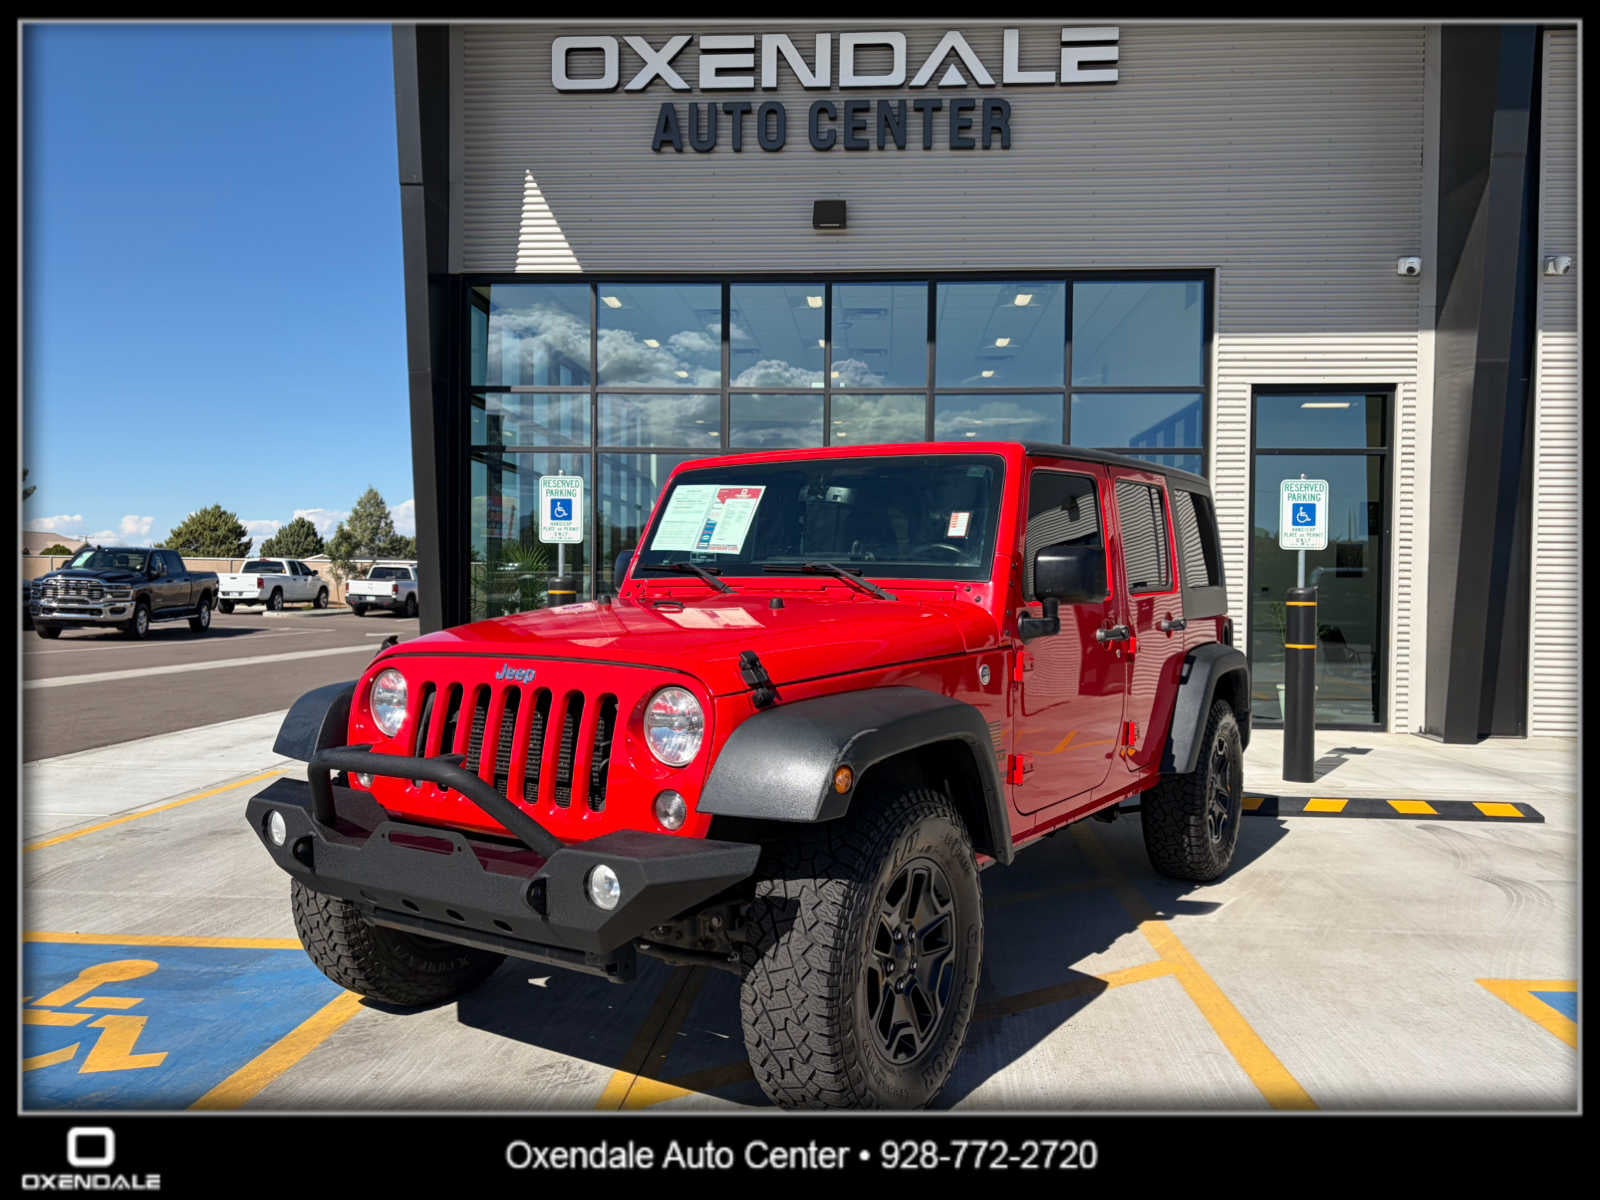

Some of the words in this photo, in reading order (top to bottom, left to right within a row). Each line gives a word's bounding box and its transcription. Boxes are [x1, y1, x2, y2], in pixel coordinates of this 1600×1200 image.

[551, 26, 1120, 93] OXENDALE
[651, 101, 787, 153] AUTO
[808, 98, 1012, 152] CENTER
[543, 479, 580, 488] RESERVED
[1284, 483, 1325, 493] RESERVED
[546, 488, 577, 498] PARKING
[1287, 492, 1321, 502] PARKING
[496, 663, 536, 685] Jeep
